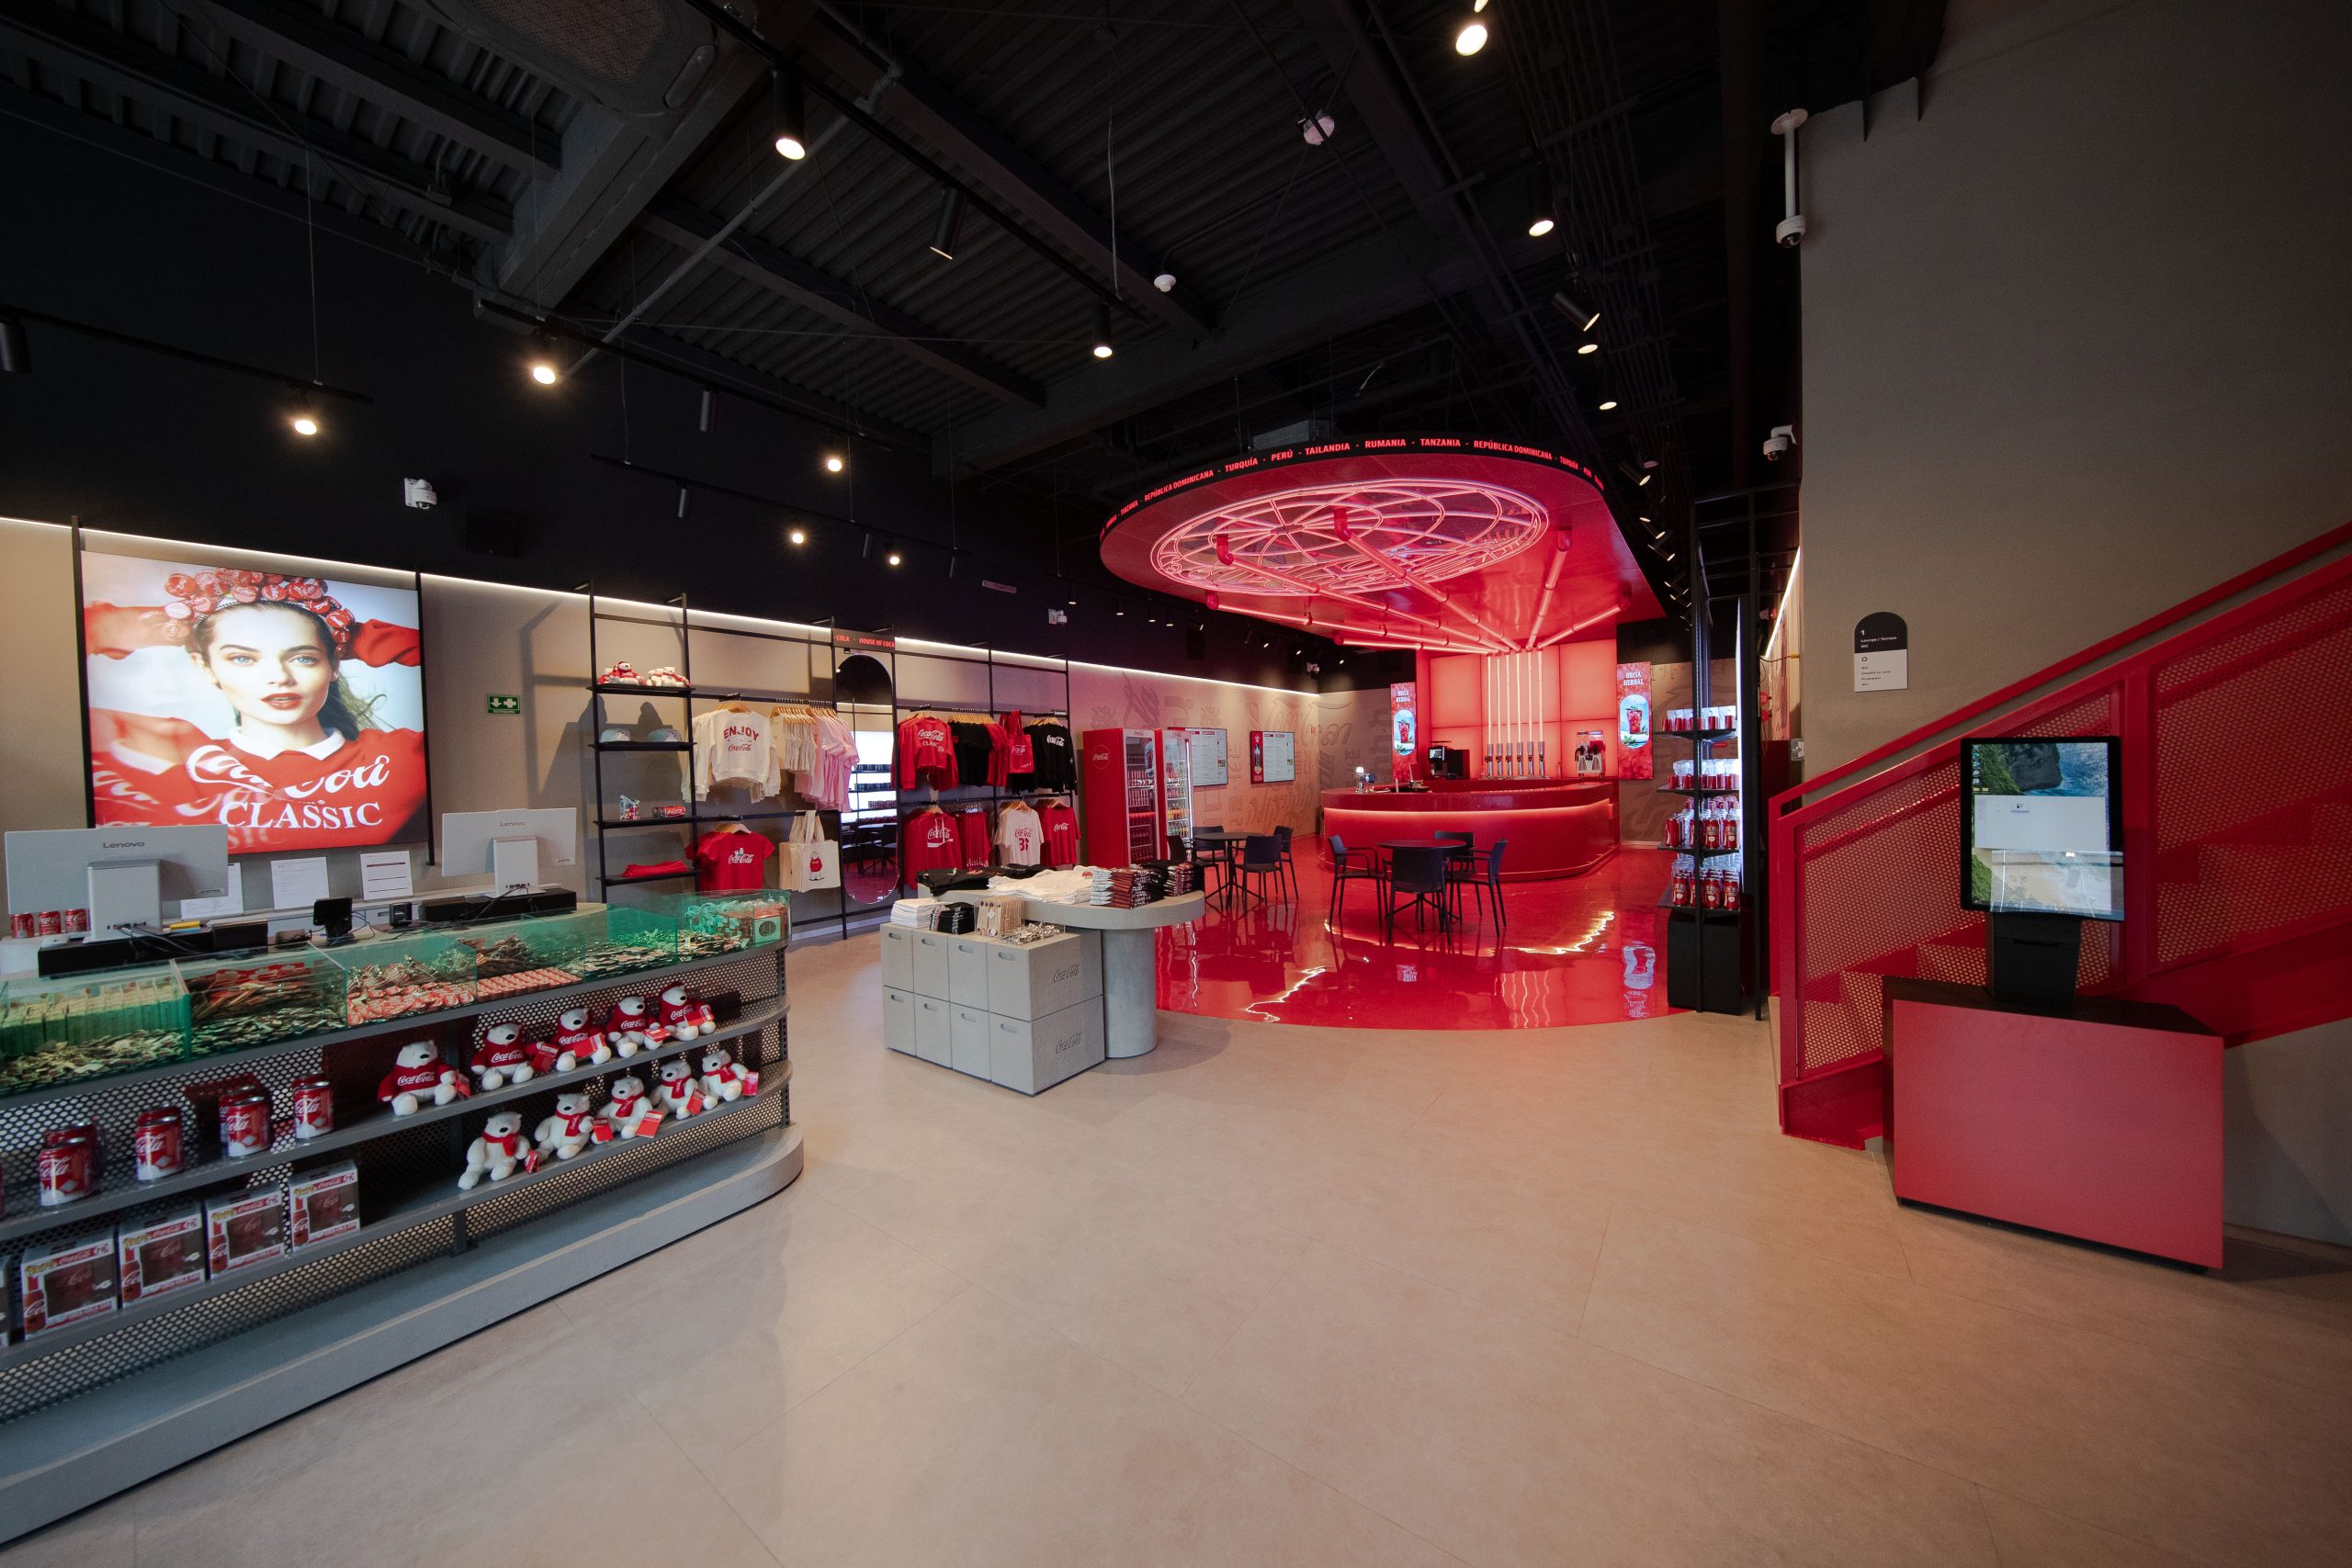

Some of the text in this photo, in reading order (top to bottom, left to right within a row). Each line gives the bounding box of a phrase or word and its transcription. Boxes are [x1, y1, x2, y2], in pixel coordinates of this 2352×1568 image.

[1144, 483, 1173, 502] REPÚBLICA
[1173, 469, 1214, 490] DOMINICANA
[1225, 457, 1258, 473] TURQUÍA
[1271, 448, 1294, 462] PERÚ
[1305, 443, 1350, 457] TAILANDIA
[1364, 438, 1406, 448] RUMANIA
[1420, 438, 1461, 447] TANZANIA
[1474, 439, 1513, 453] REPÚBLICA
[1514, 445, 1553, 461] DOMINICANA
[859, 637, 876, 646] HOUSE
[723, 726, 760, 741] ENJOY
[918, 728, 945, 741] Coca-Cola
[1093, 752, 1110, 761] Coca-Cola
[219, 801, 383, 829] CLASSIC
[1054, 822, 1070, 831] Coca-Cola
[728, 852, 754, 864] Coca-Cola
[1053, 964, 1080, 983] Coca-Cola
[1055, 1032, 1082, 1055] Coca-Cola
[397, 1071, 435, 1087] Coca-Cola
